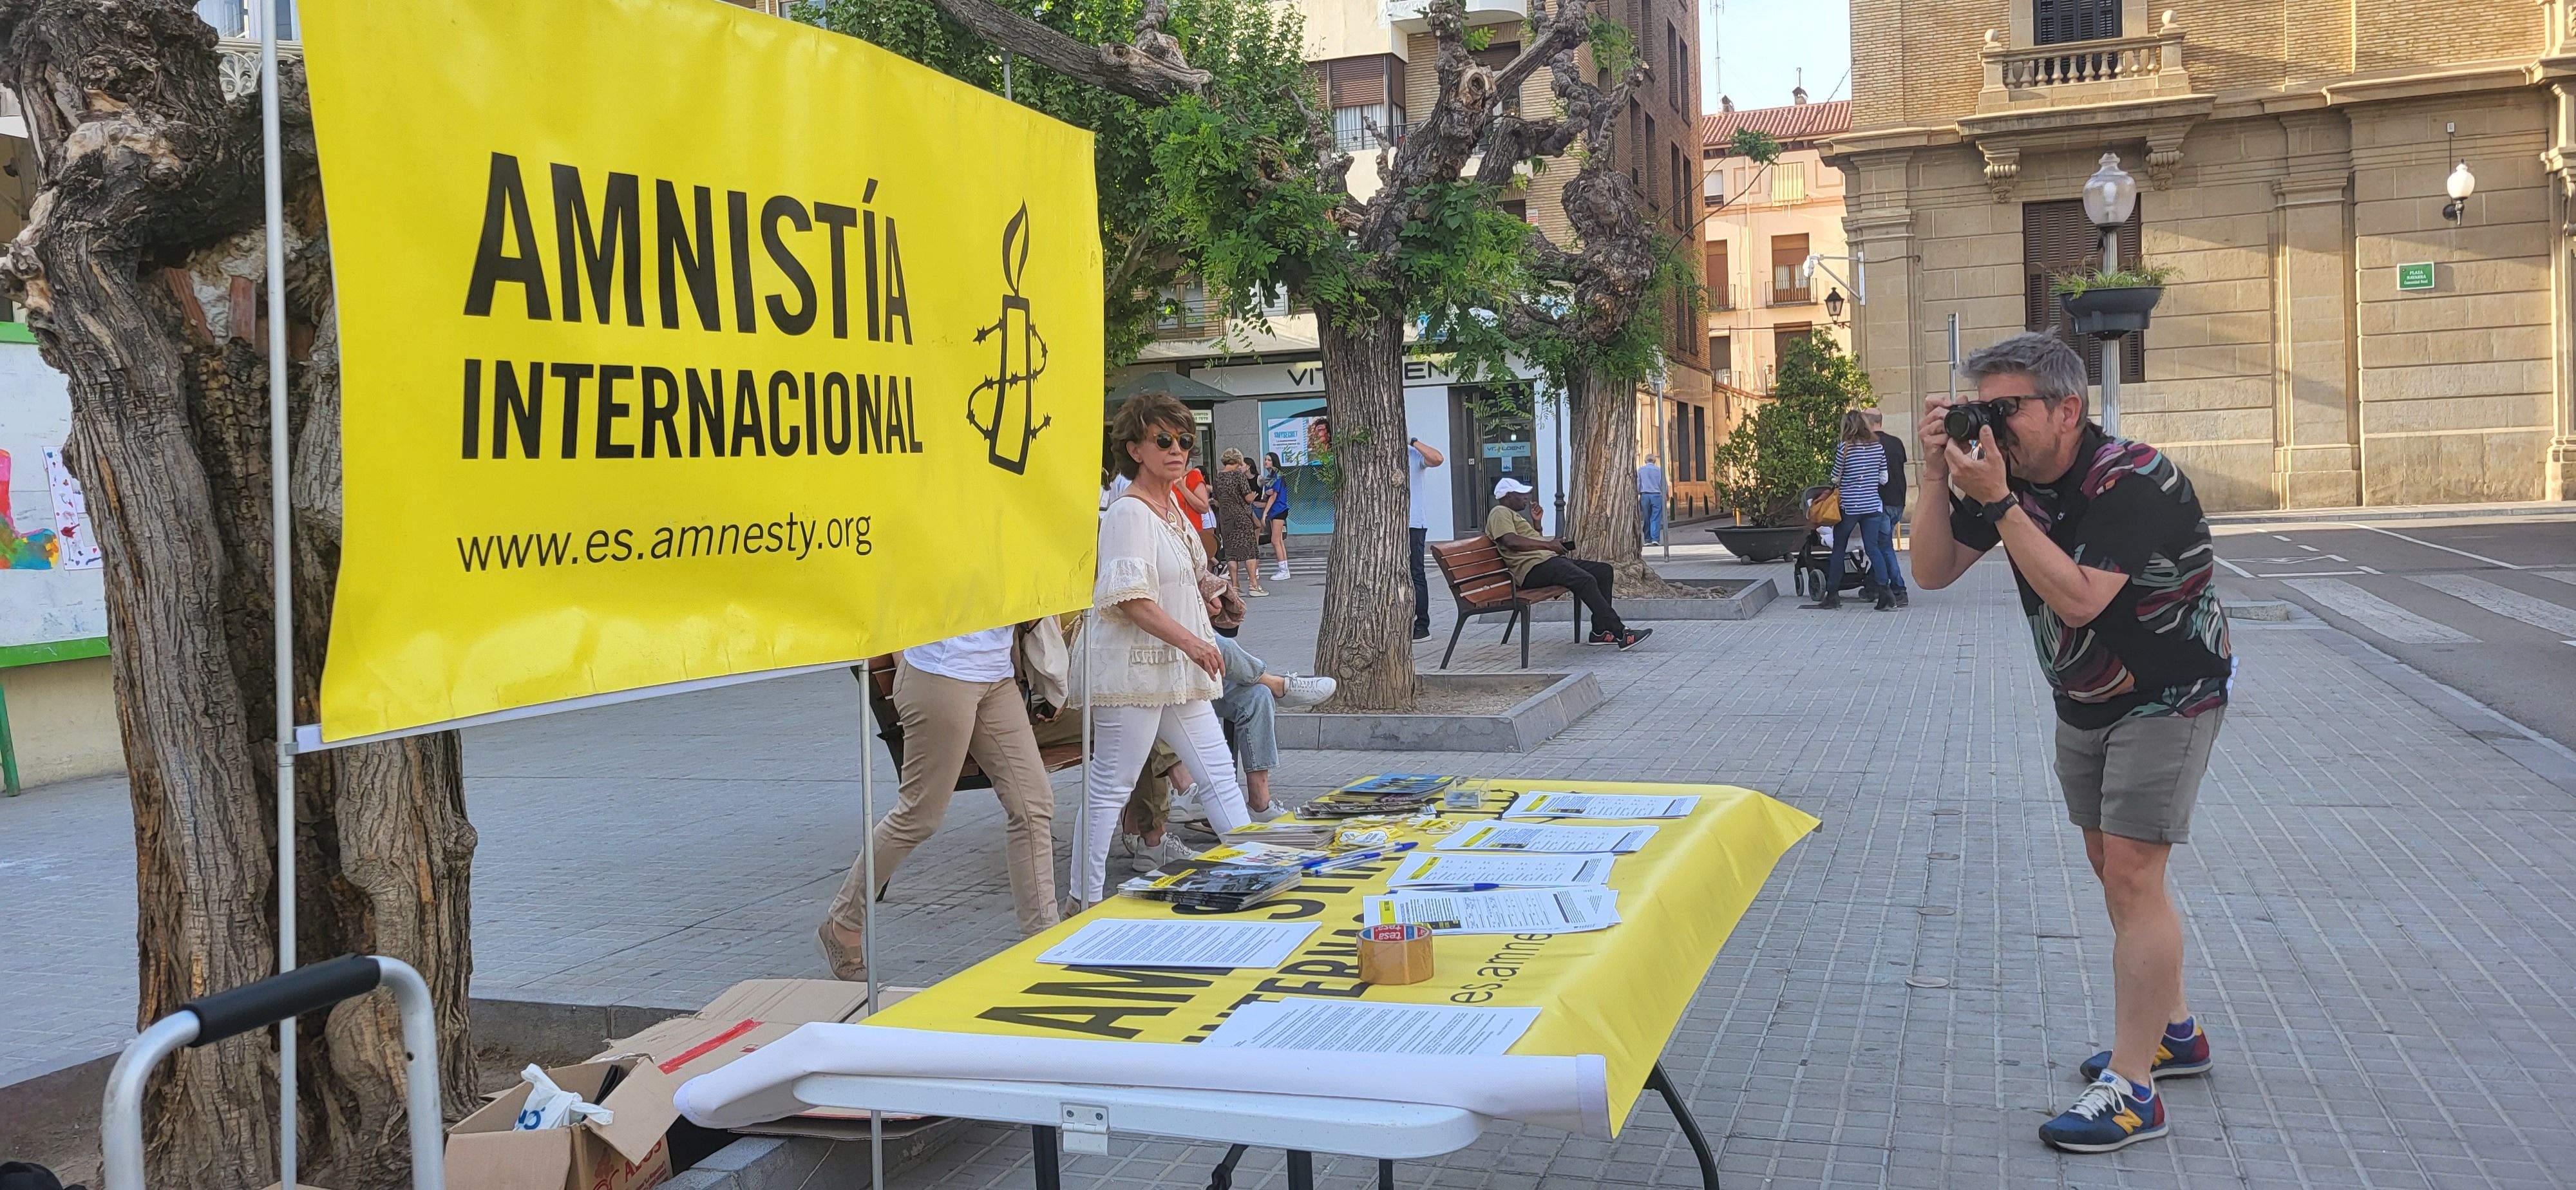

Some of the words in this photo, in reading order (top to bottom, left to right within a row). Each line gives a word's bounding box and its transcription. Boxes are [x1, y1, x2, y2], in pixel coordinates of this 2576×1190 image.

[463, 152, 913, 345] AMNISTÍA
[461, 358, 923, 459] INTERNACIONAL
[457, 513, 872, 572] www.es.amnesty.org
[1378, 932, 1402, 940] tesa
